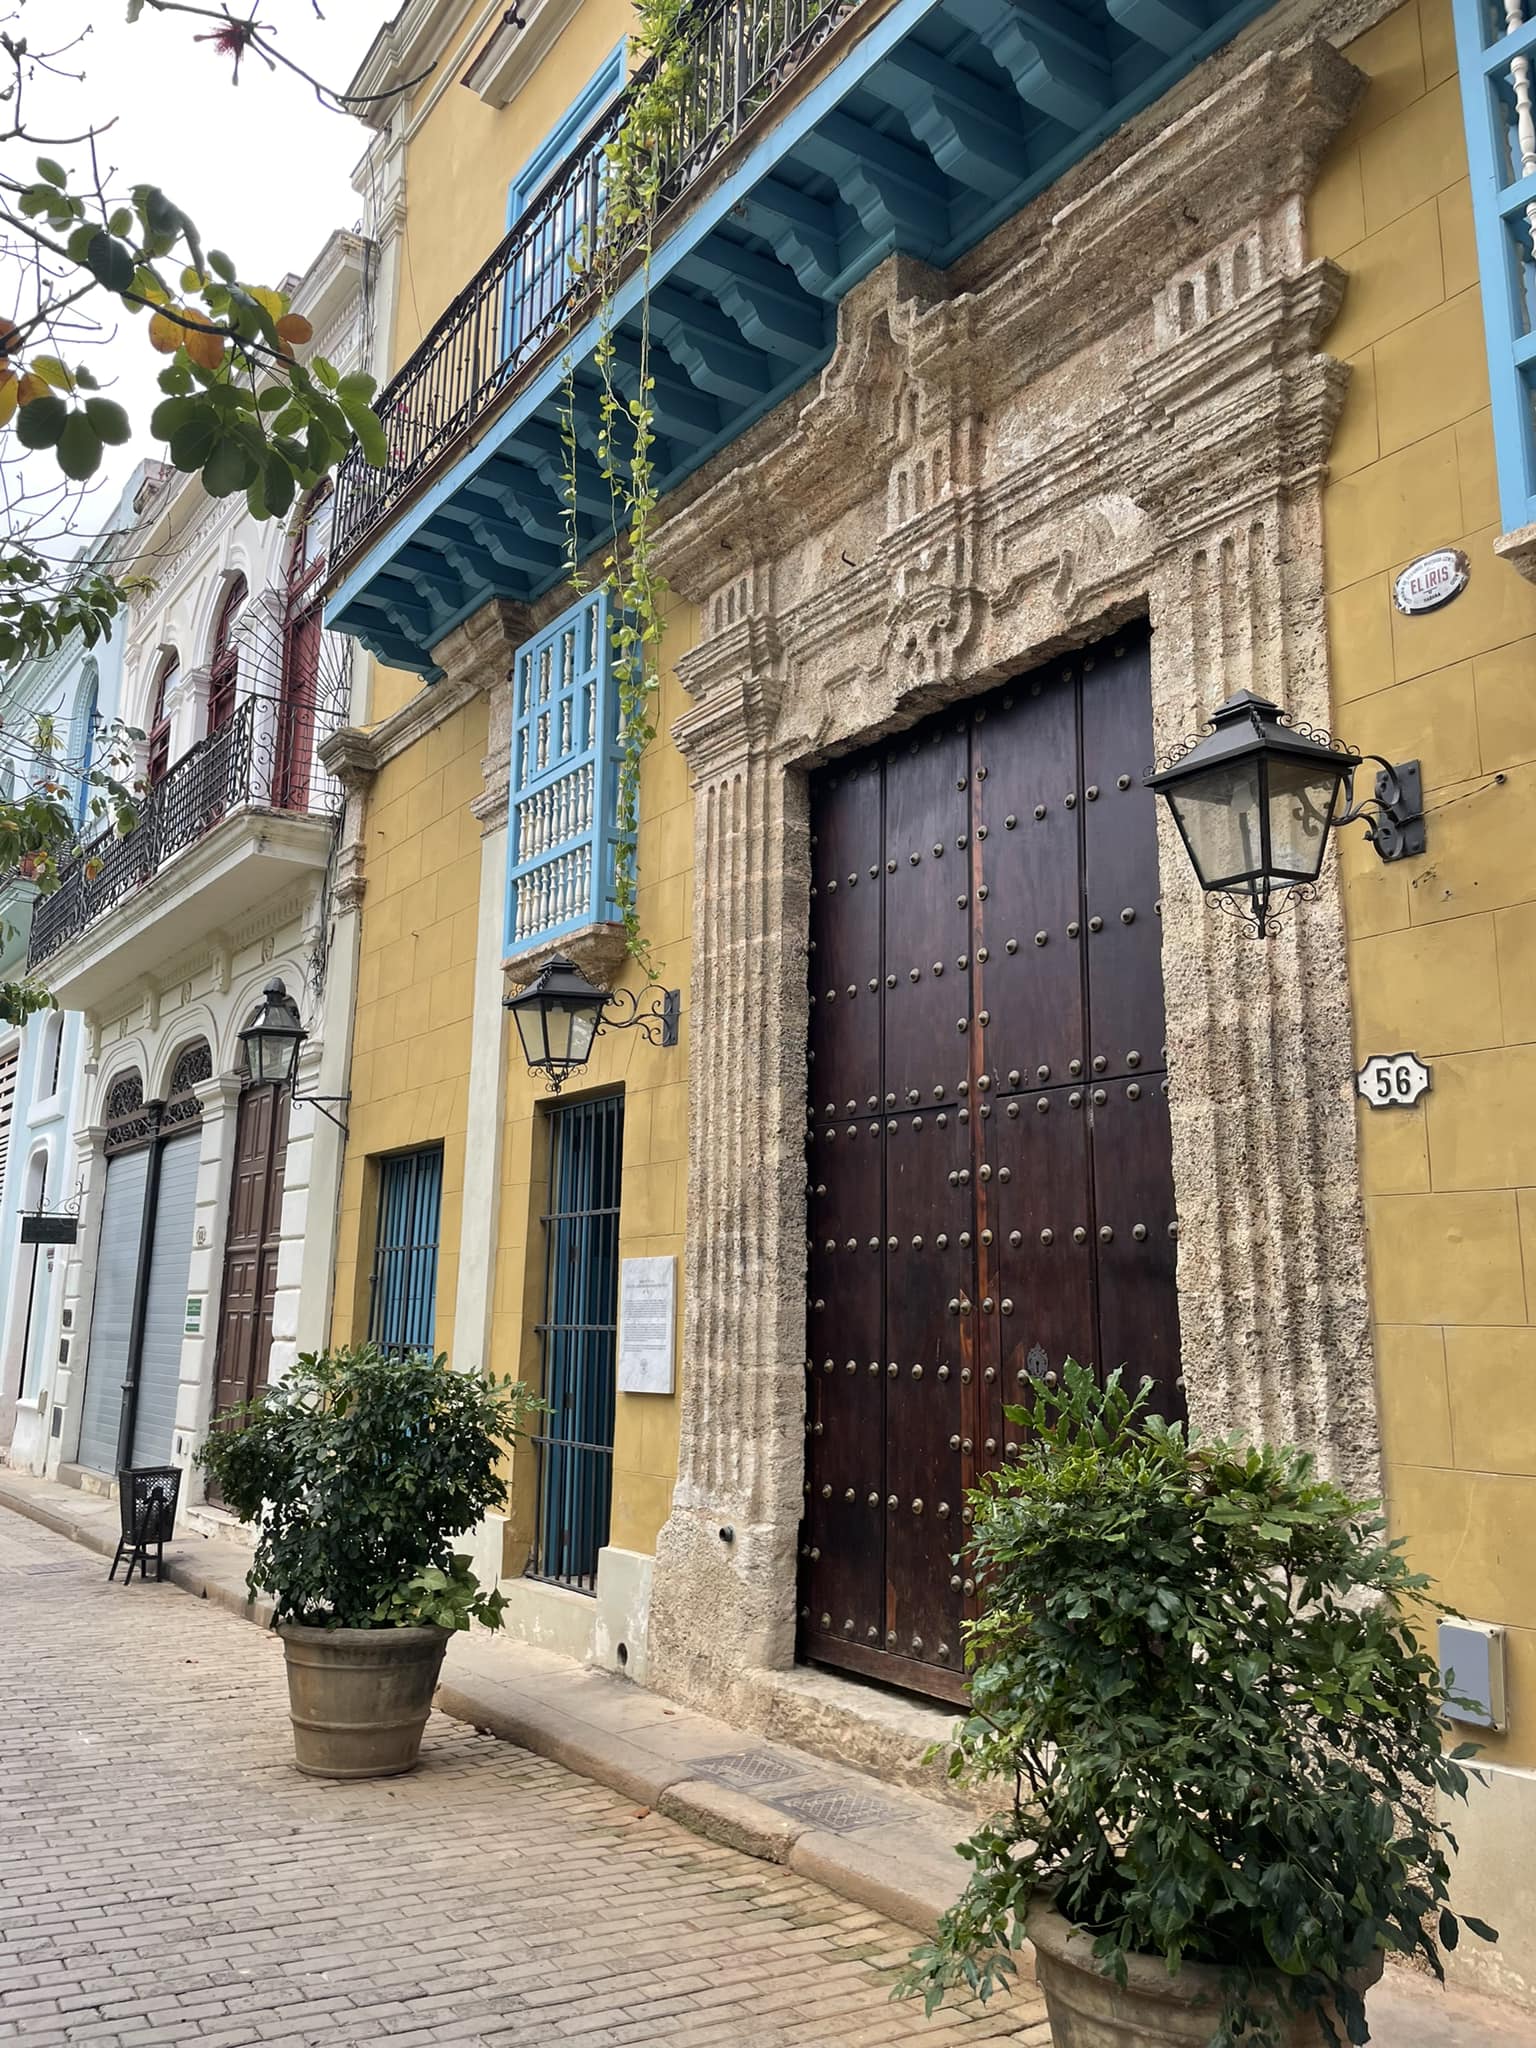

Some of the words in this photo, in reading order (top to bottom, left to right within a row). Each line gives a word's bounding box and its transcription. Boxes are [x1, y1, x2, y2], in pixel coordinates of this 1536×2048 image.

[1410, 577, 1423, 595] EL
[1425, 566, 1449, 588] IRIS
[1376, 1066, 1411, 1097] 56
